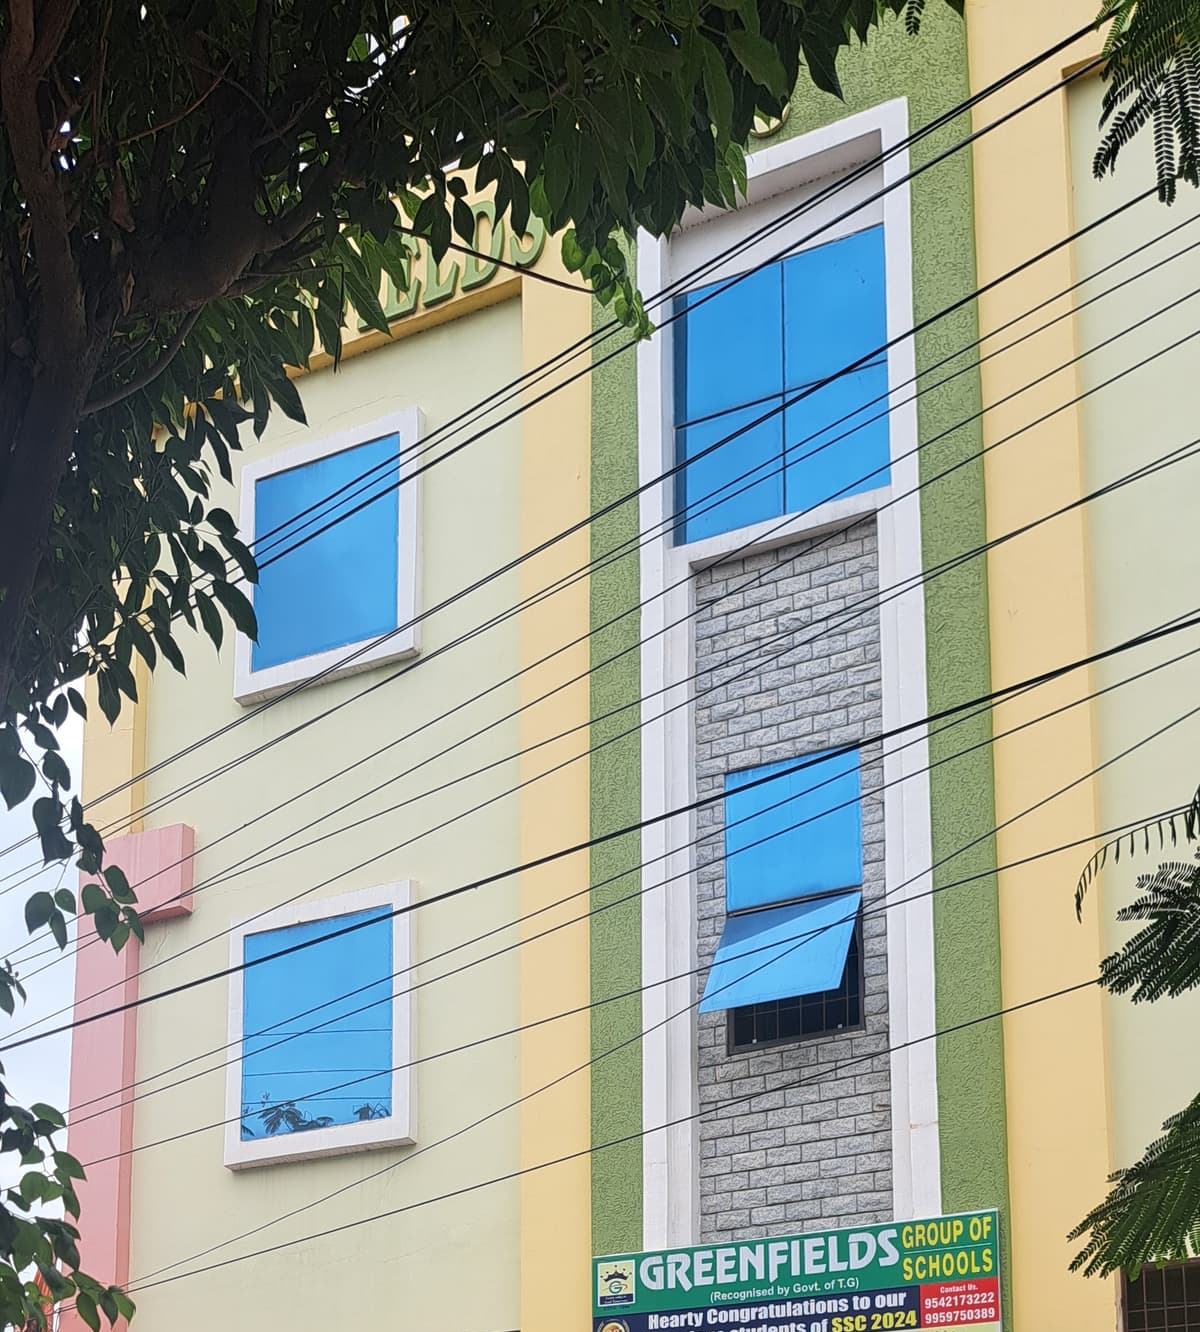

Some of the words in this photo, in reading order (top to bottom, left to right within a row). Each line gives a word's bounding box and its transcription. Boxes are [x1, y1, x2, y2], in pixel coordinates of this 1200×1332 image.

[639, 1229, 900, 1292] GREENFIELDS
[902, 1220, 963, 1249] GROUP
[969, 1216, 992, 1241] OF
[903, 1249, 993, 1281] SCHOOLS
[710, 1288, 774, 1304] (Recognised
[777, 1285, 790, 1297] by
[793, 1282, 821, 1293] Govt.
[825, 1279, 836, 1291] of
[837, 1277, 859, 1289] T.G)
[924, 1292, 995, 1309] 9542173222
[940, 1284, 965, 1294] Contact
[648, 1311, 703, 1330] Hearty
[707, 1298, 848, 1325] Congratulations
[853, 1295, 871, 1311] to
[875, 1292, 907, 1308] our
[870, 1310, 918, 1331] 2024
[925, 1307, 996, 1324] 9959750389
